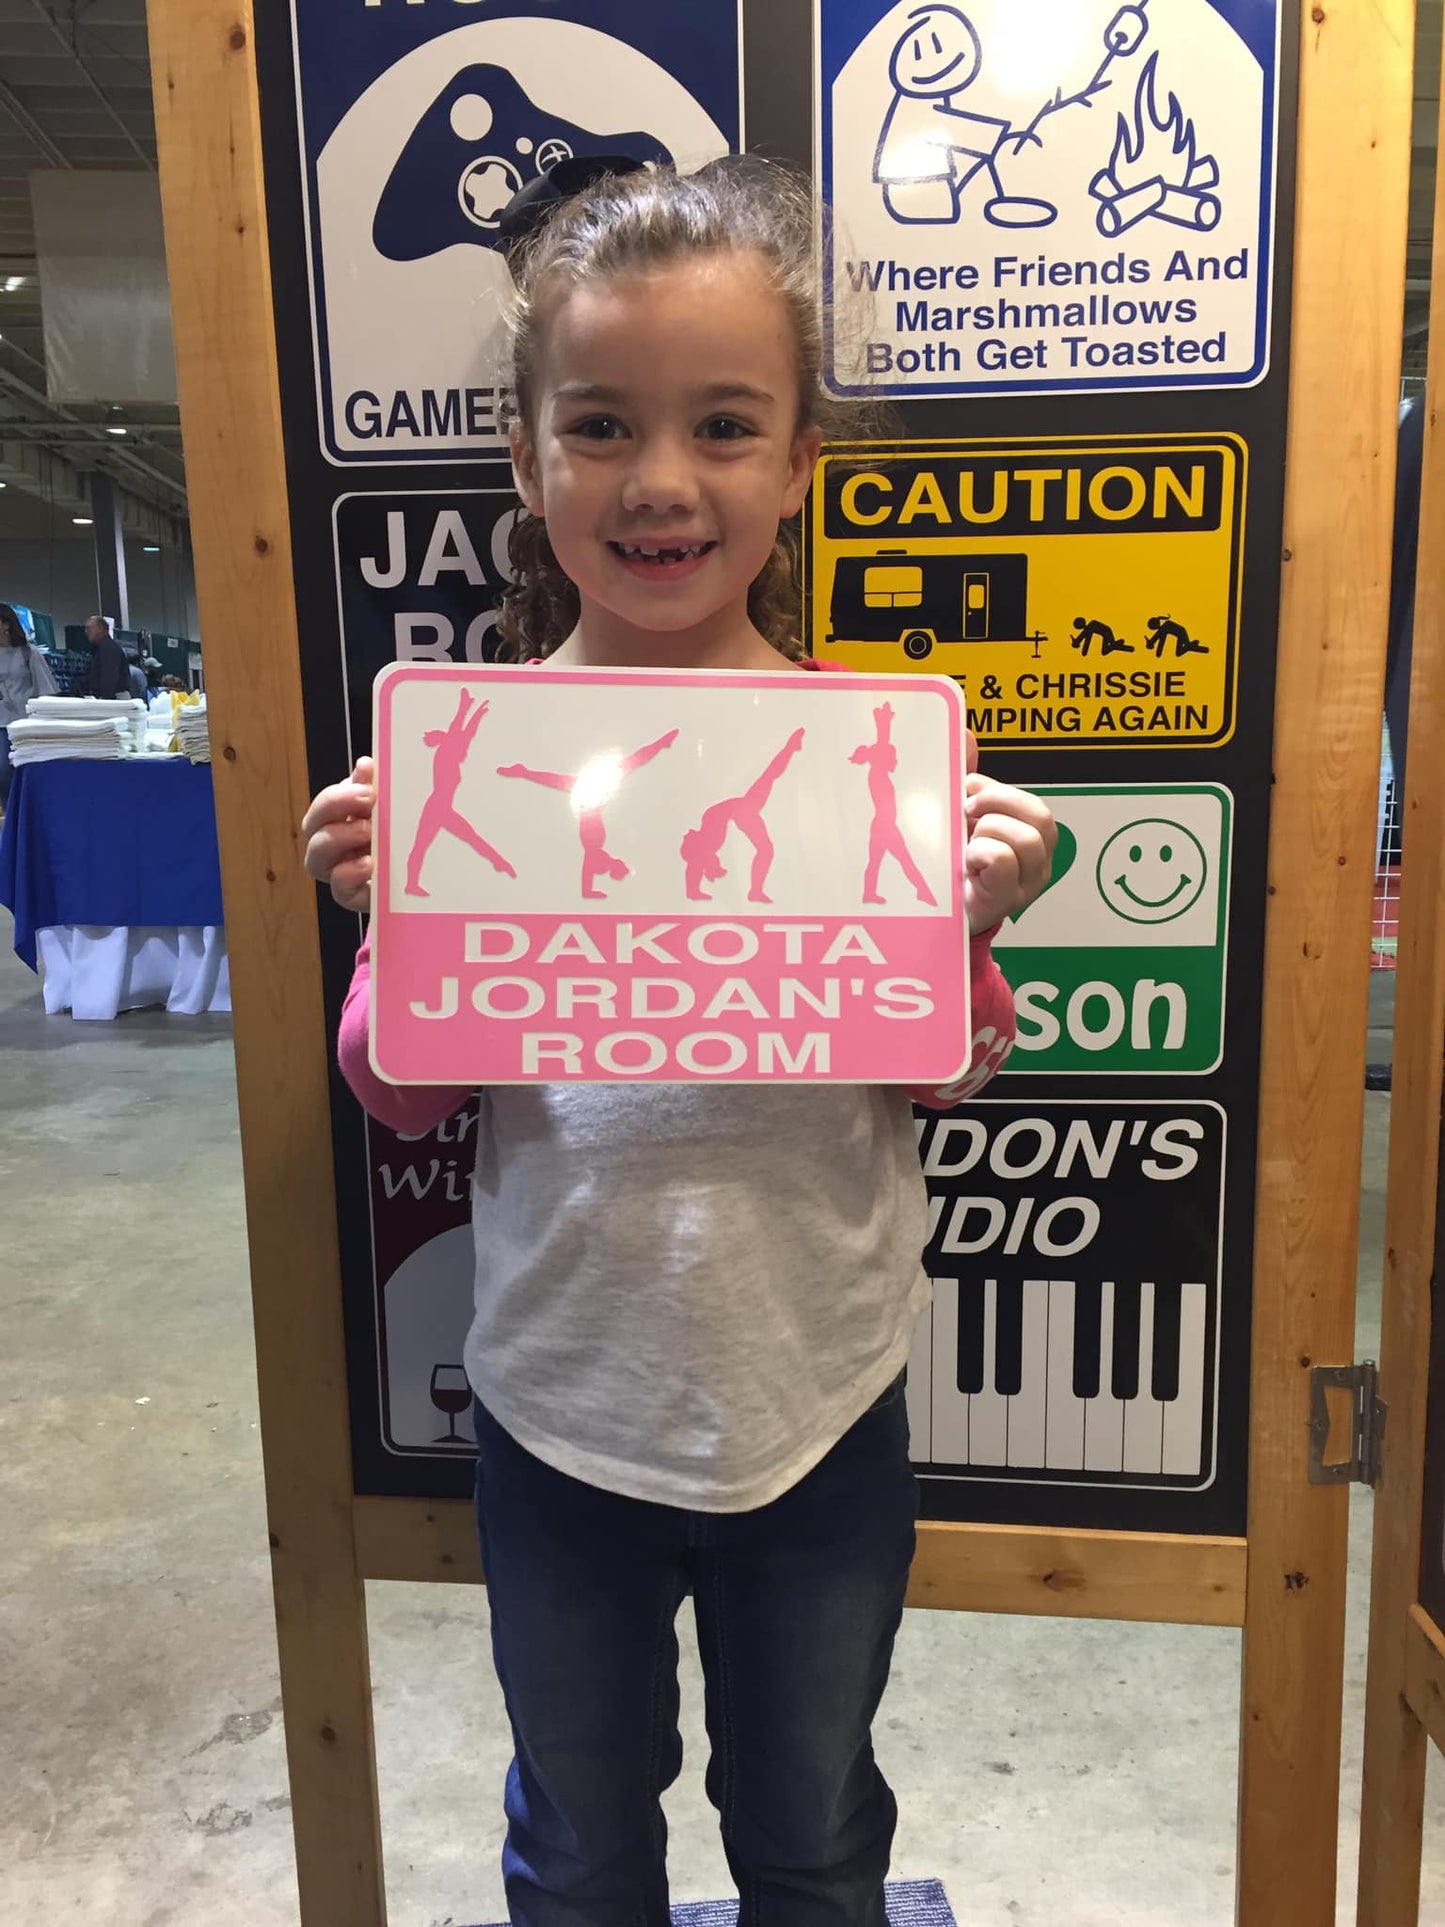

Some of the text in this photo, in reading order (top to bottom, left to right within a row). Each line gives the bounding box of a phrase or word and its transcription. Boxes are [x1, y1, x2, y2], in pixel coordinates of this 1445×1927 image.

[846, 247, 1249, 293] Where Friends And
[895, 295, 1198, 332] Marshmallows
[866, 331, 1227, 374] Both Get Toasted
[839, 465, 1206, 526] CAUTION
[980, 674, 1003, 700] &
[1016, 671, 1186, 699] CHRISSIE
[1092, 704, 1208, 731] AGAIN
[464, 922, 888, 965] DAKOTA
[409, 976, 935, 1019] JORDAN'S
[522, 1031, 831, 1074] ROOM
